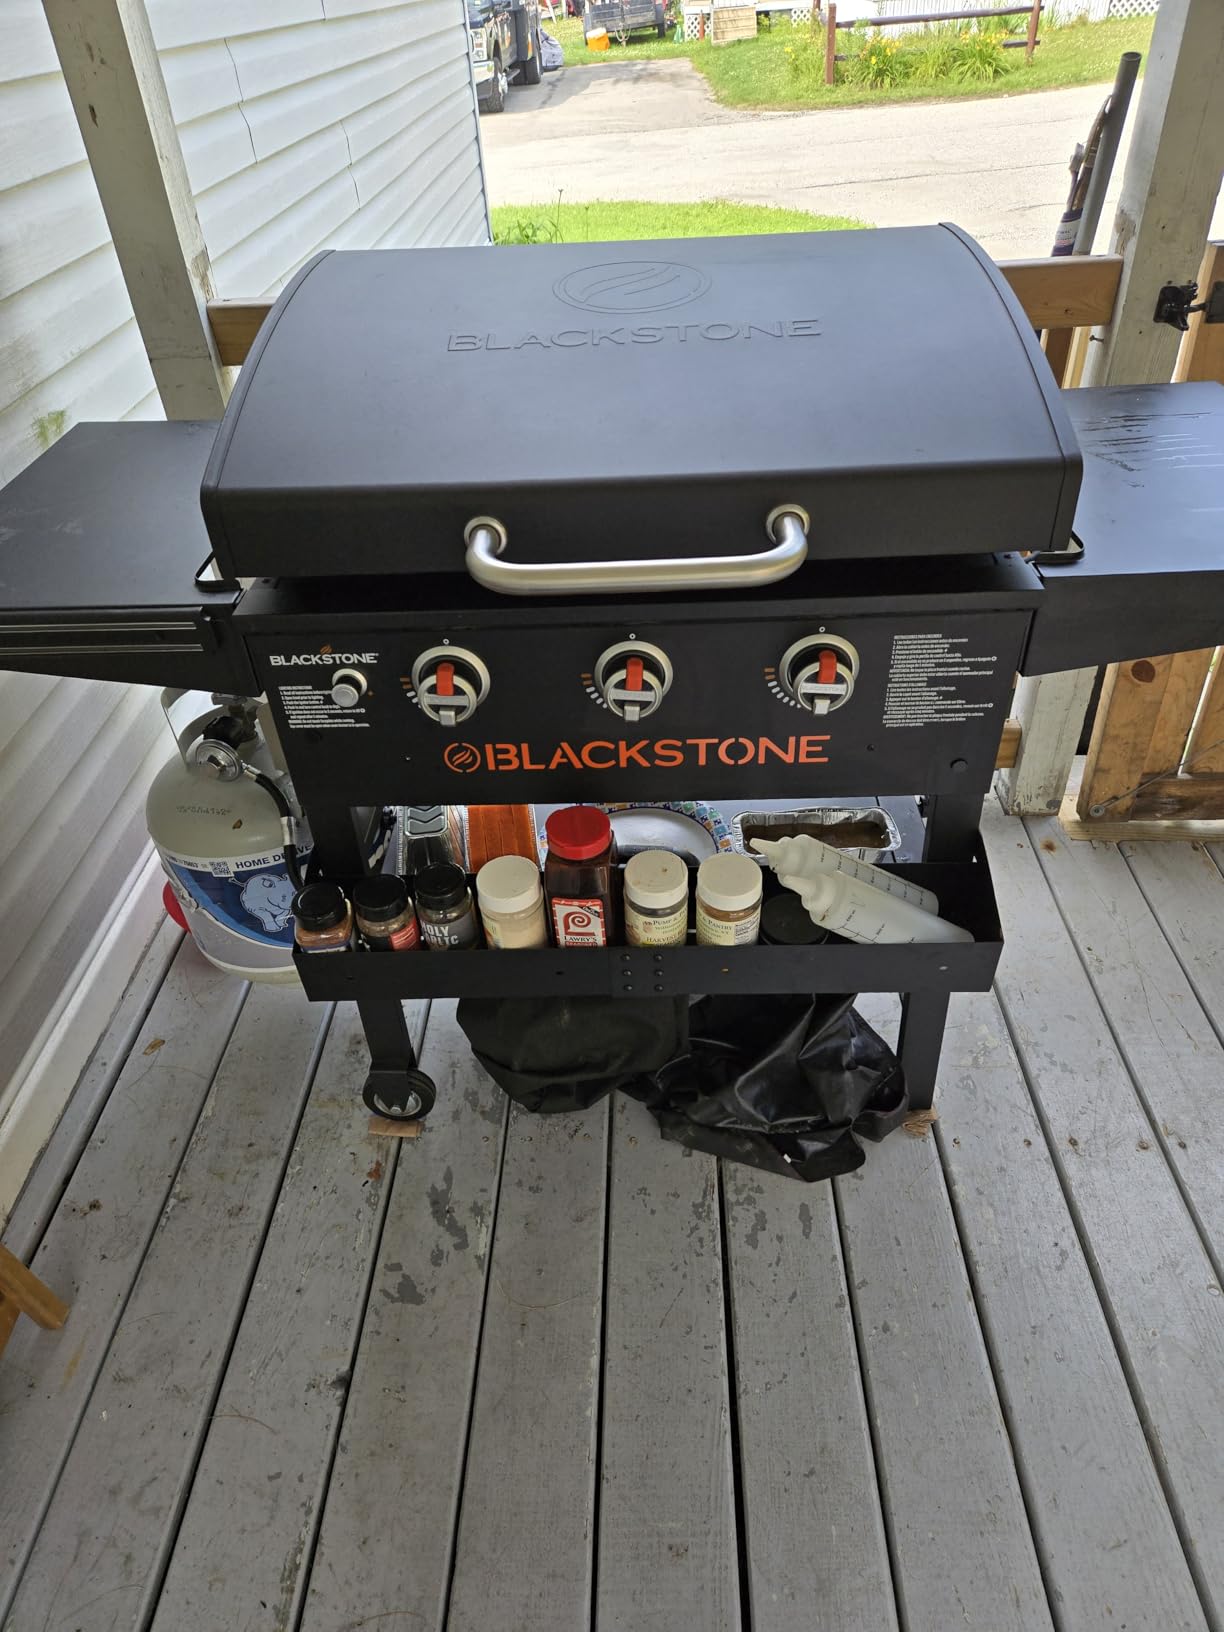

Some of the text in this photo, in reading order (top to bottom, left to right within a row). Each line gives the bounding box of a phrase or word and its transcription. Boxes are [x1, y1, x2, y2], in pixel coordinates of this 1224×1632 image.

[446, 319, 823, 352] BLACKSTONE
[269, 652, 378, 666] BLACKSTONE
[484, 735, 831, 770] BLACKSTONE
[235, 857, 270, 869] HOME
